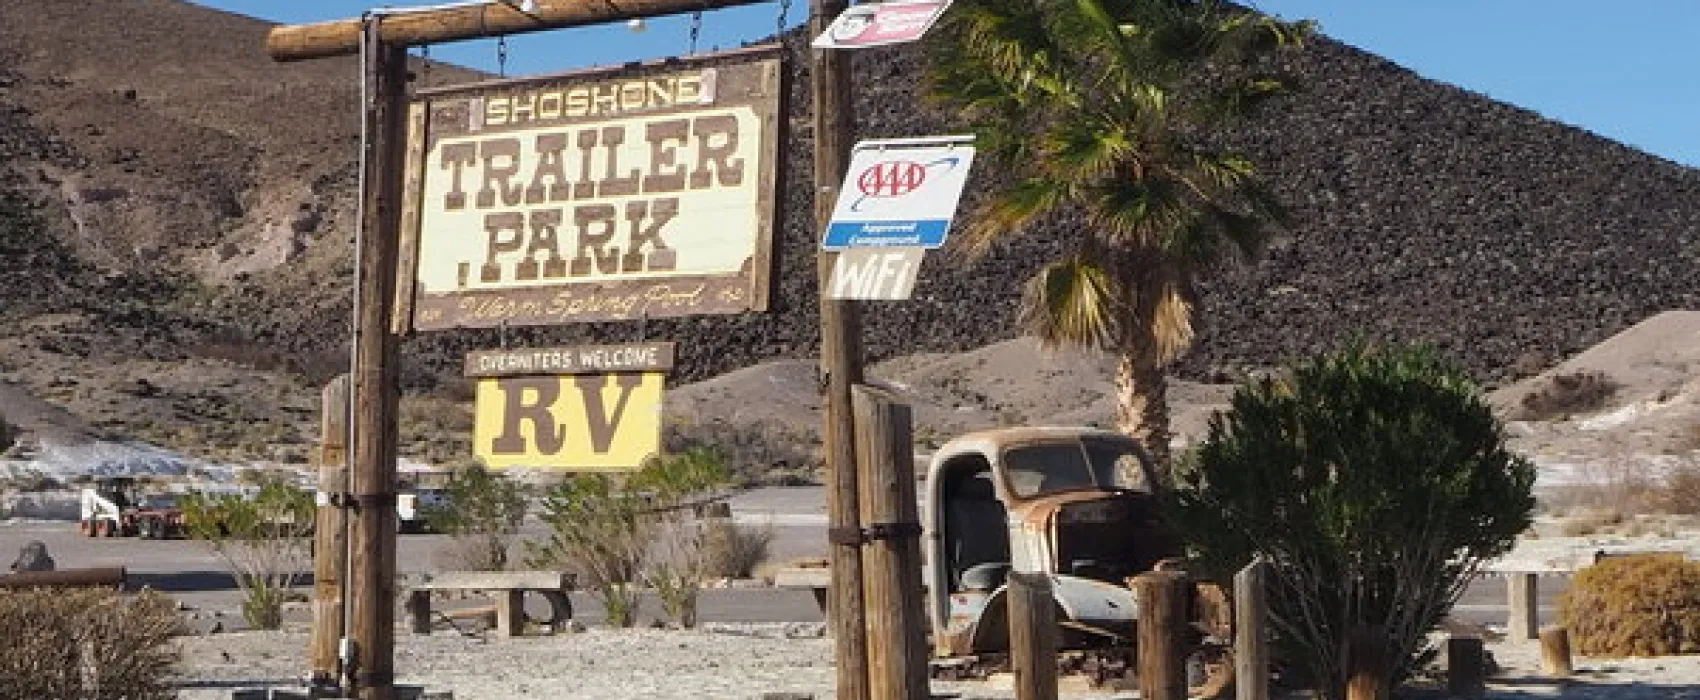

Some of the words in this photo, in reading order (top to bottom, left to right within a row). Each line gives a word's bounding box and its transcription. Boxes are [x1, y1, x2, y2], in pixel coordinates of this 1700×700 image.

[485, 75, 702, 125] SHOSHONE
[441, 115, 745, 210] TRAILER
[857, 161, 926, 197] AAA
[481, 197, 680, 283] PARK
[480, 351, 572, 371] OVERNITERS
[579, 347, 658, 367] WELCOME
[491, 374, 643, 456] RV
